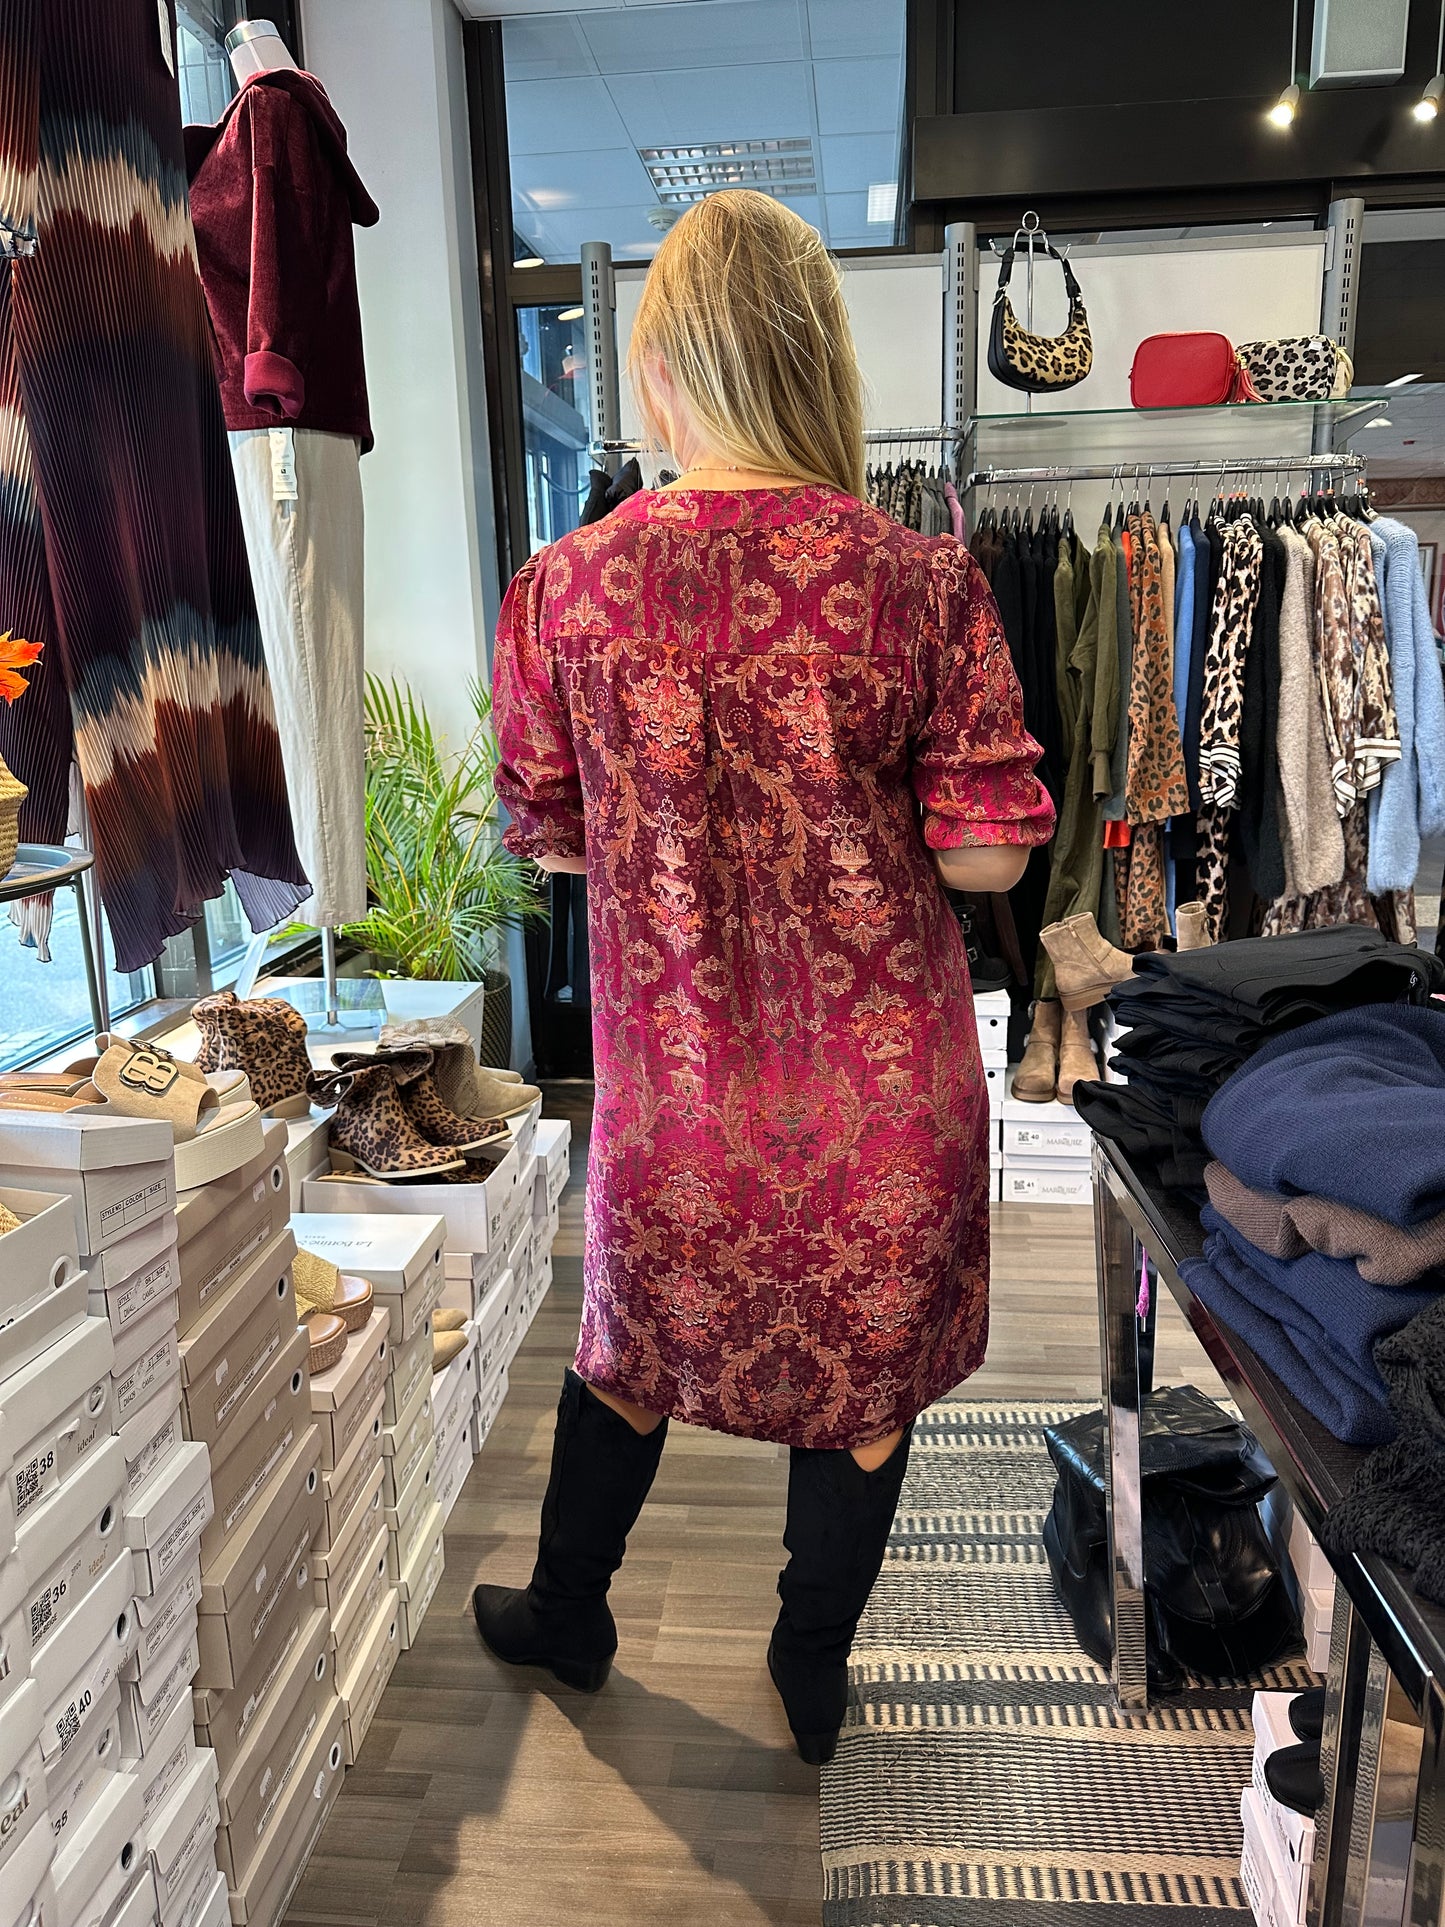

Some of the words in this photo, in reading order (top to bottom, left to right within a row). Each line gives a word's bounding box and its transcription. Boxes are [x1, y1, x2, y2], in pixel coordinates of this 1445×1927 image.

[125, 1193, 143, 1206] COLOR
[149, 1183, 161, 1193] SIZE
[77, 1429, 96, 1454] ideal
[40, 1450, 54, 1475] 38
[88, 1551, 107, 1576] ideal
[52, 1580, 67, 1603] 36
[79, 1690, 92, 1715] 40
[54, 1809, 68, 1837] 38
